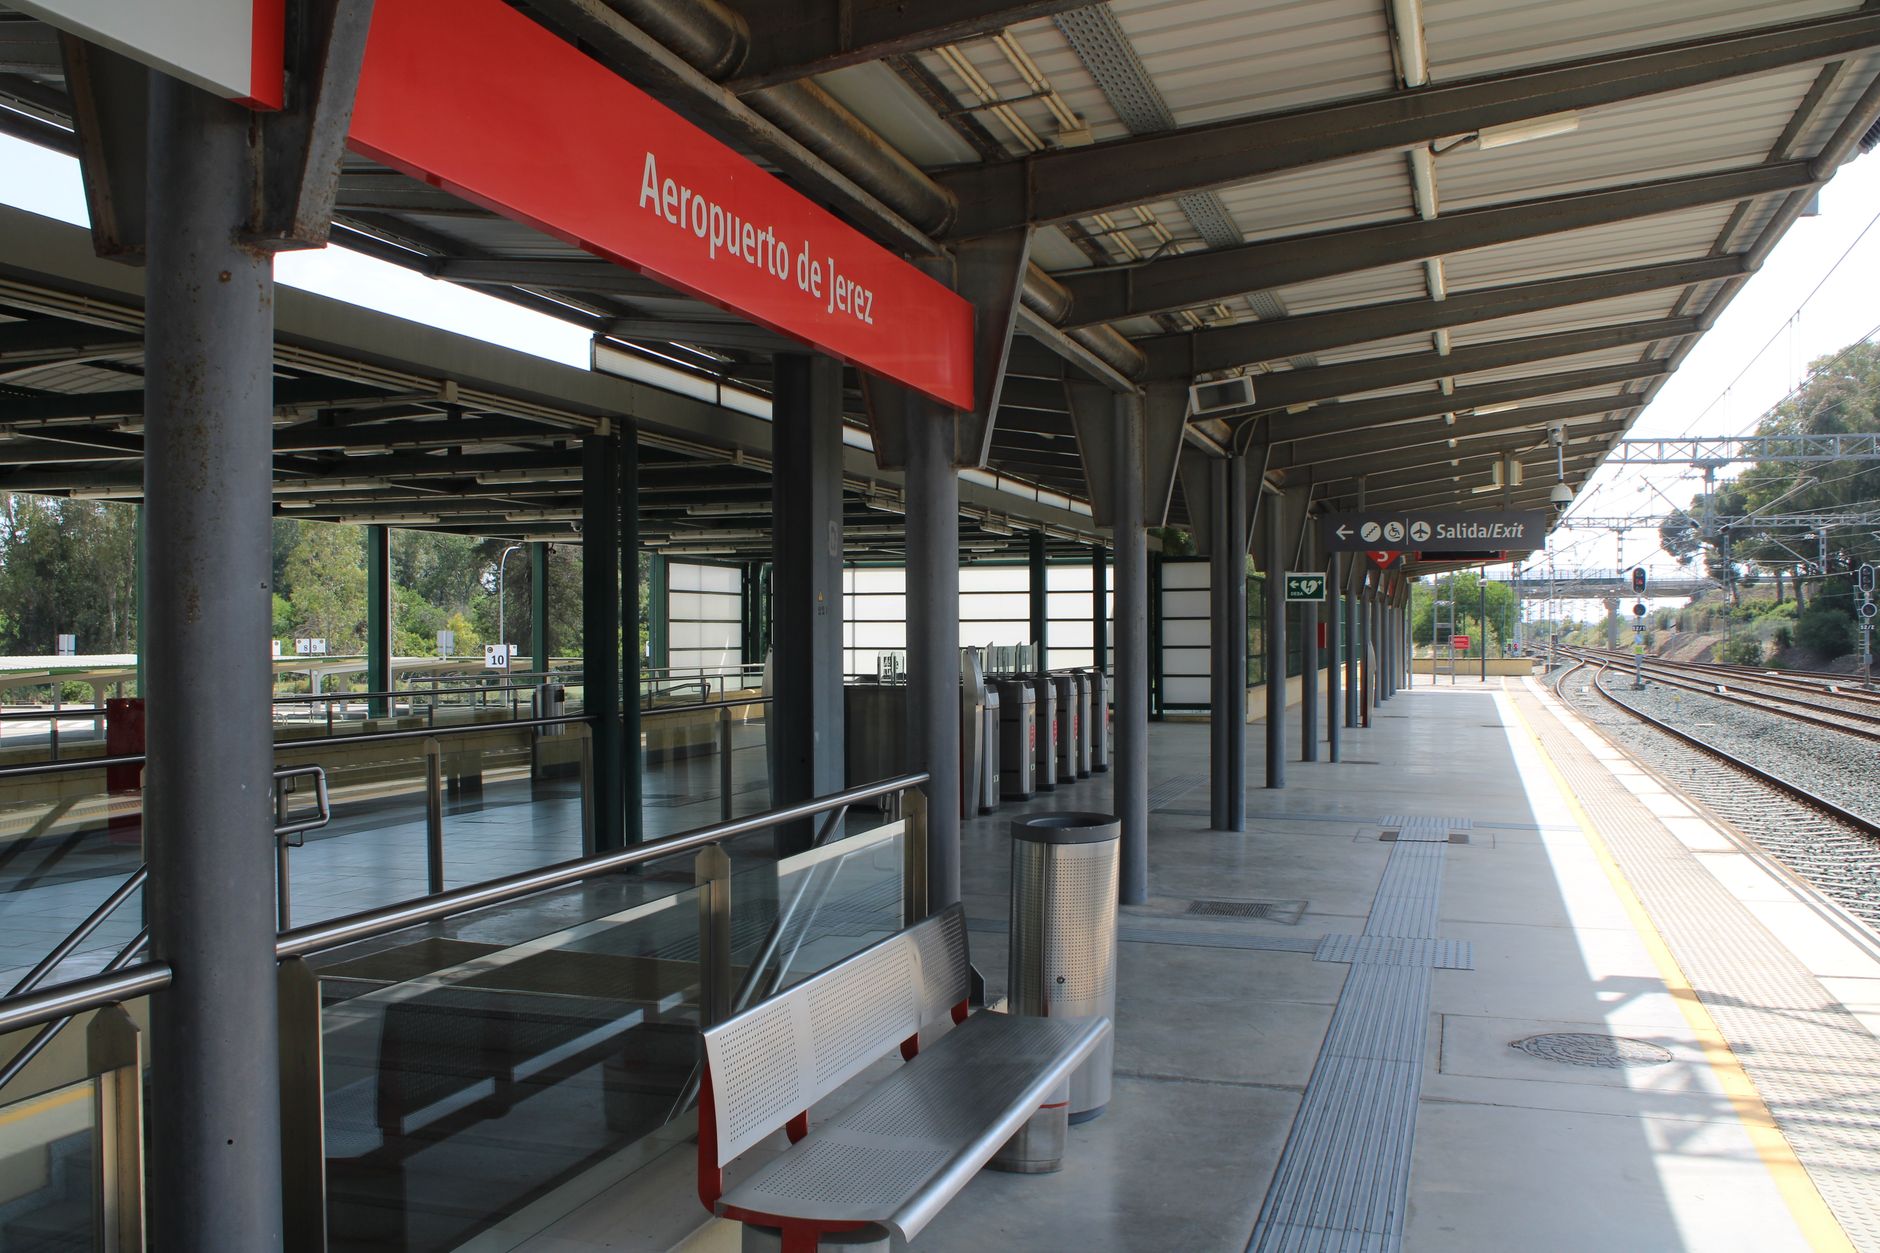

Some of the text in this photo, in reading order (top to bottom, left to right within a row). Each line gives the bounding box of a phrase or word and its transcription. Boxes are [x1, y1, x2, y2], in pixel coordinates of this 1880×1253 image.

[639, 151, 873, 325] Aeropuerto de Jerez
[1436, 522, 1524, 539] Salida/Exit
[491, 655, 504, 665] 10
